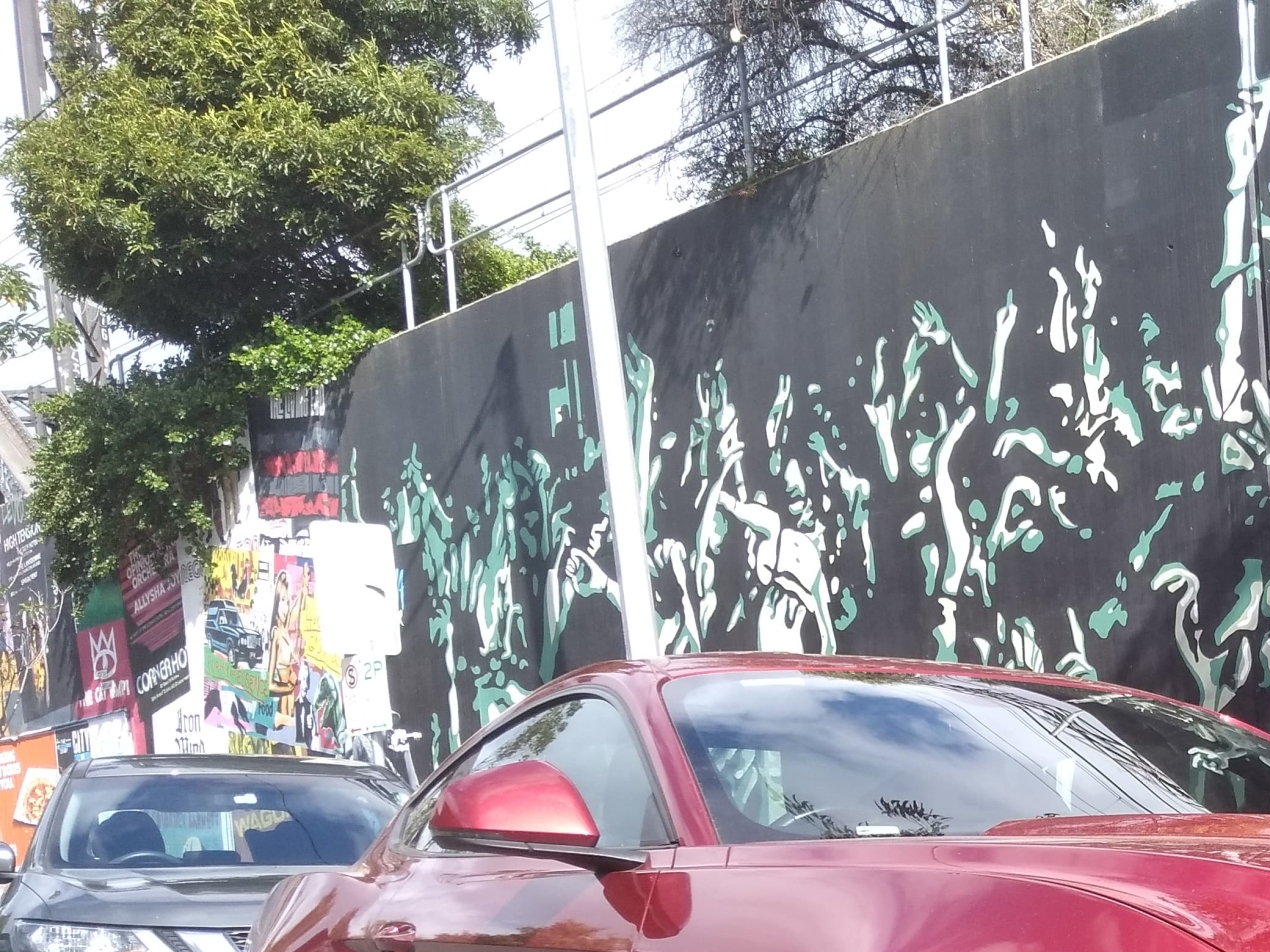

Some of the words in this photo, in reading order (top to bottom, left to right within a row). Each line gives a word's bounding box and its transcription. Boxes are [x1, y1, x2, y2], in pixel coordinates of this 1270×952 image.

[134, 582, 166, 615] ALLYSHA
[363, 660, 383, 681] 2P
[175, 707, 201, 734] Iron
